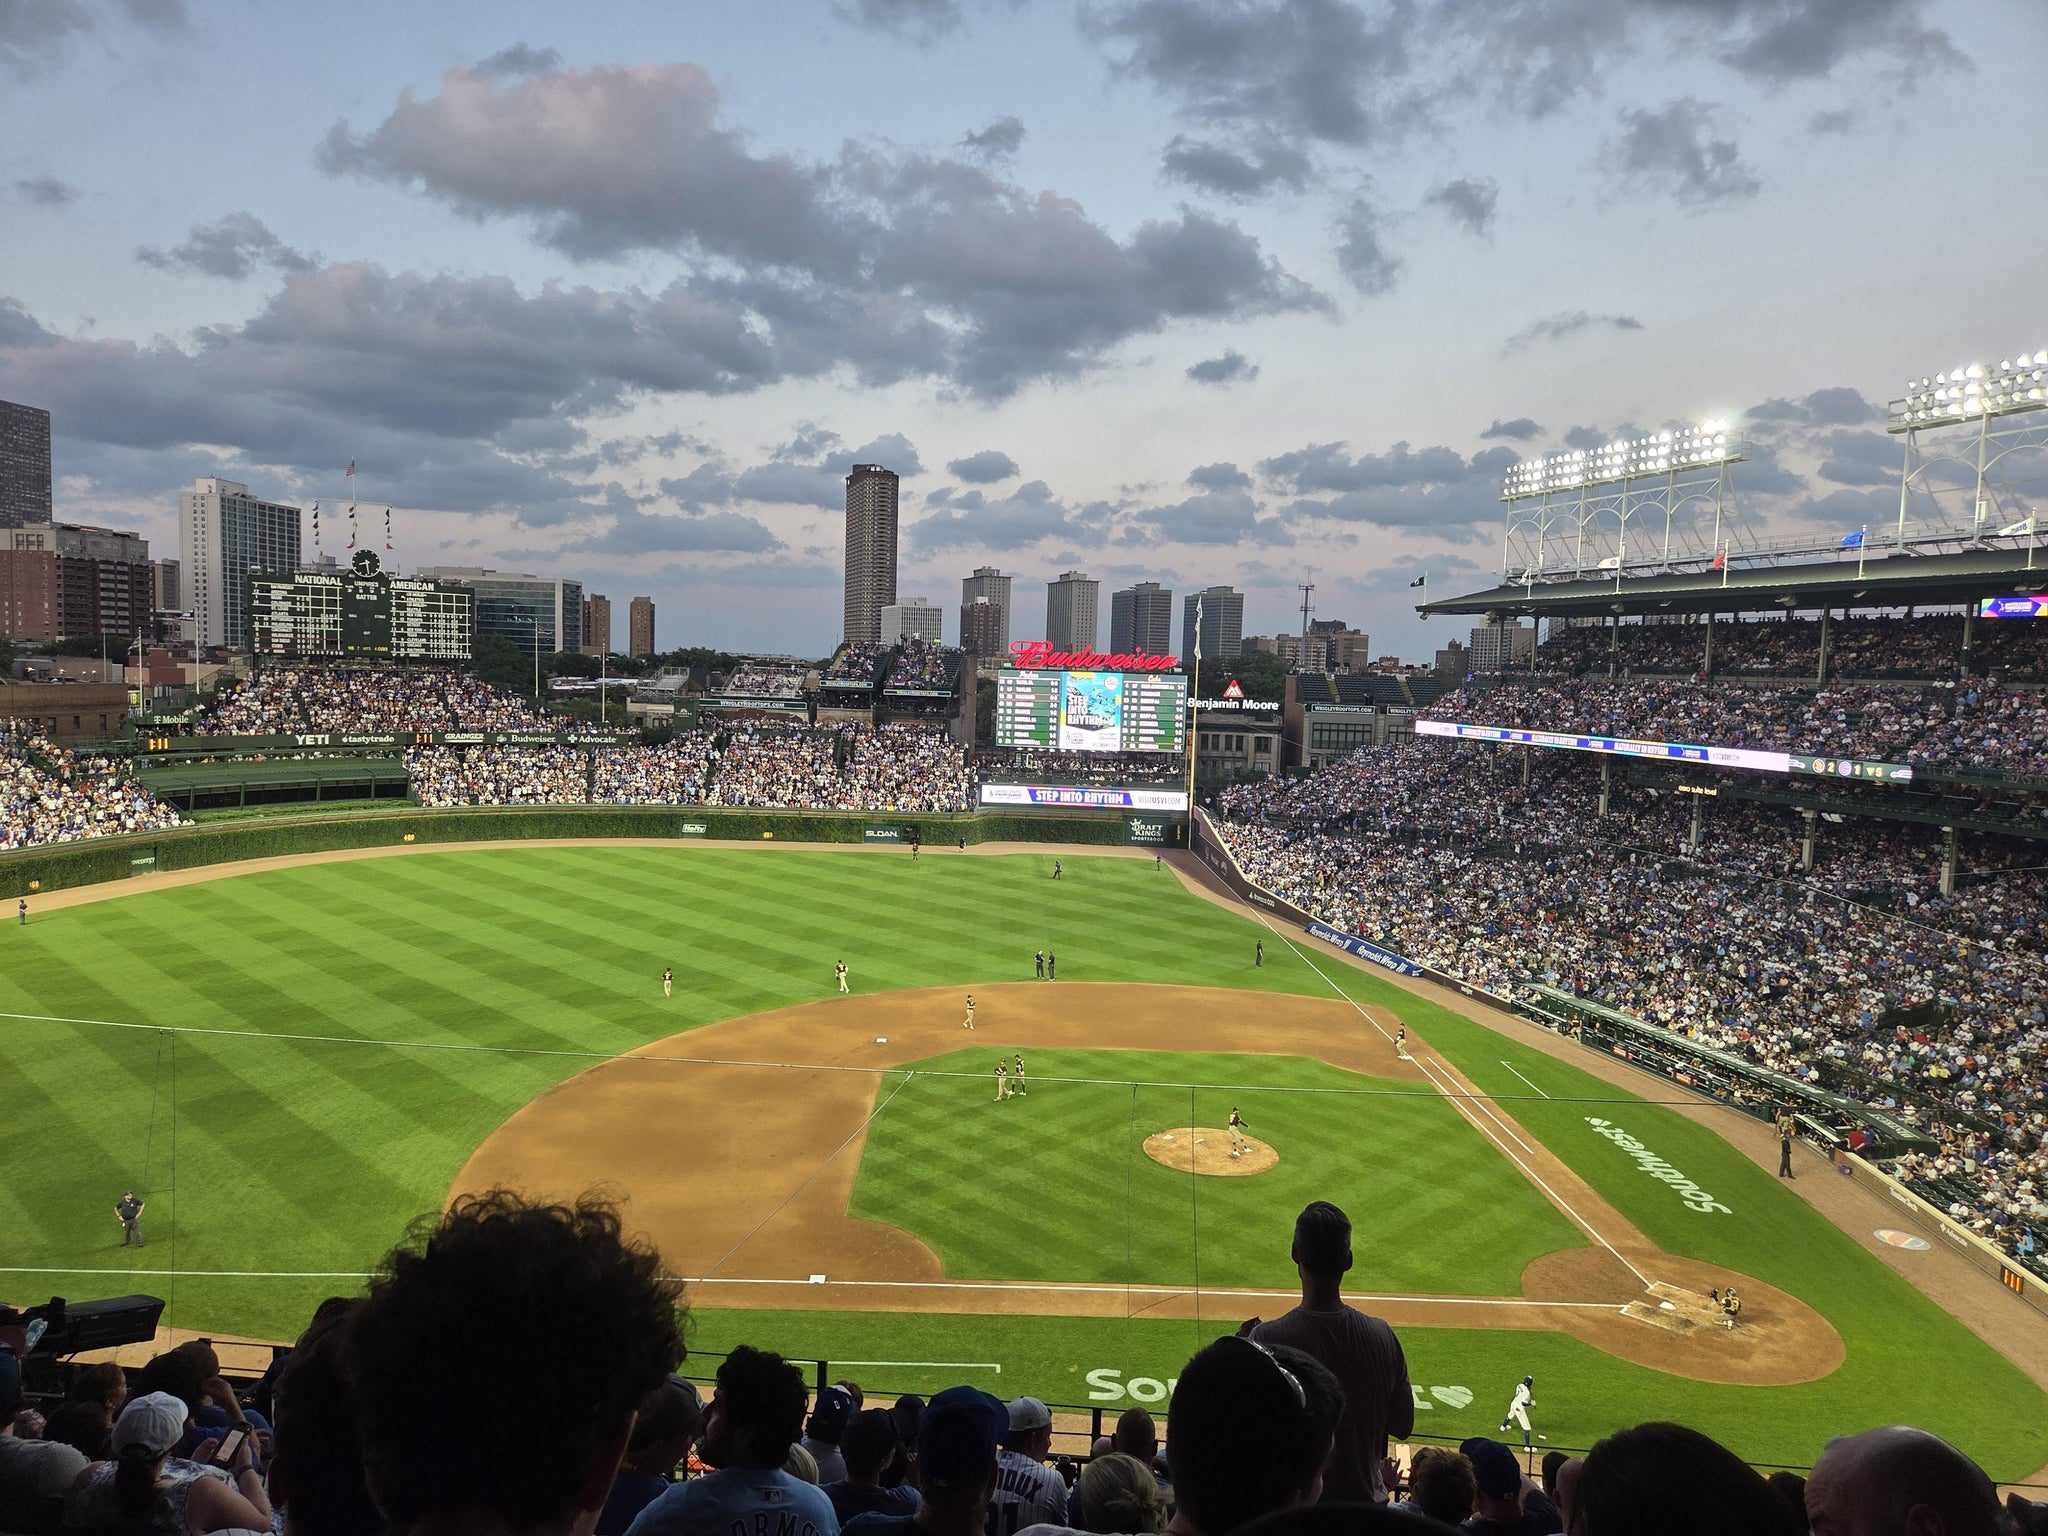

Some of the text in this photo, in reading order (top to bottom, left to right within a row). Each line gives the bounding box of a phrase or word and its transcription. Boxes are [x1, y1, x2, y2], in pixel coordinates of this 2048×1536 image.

[295, 575, 342, 585] NATIONAL
[390, 581, 434, 591] AMERICAN
[1009, 640, 1179, 670] Budweiser
[1068, 696, 1088, 704] STEP
[1188, 698, 1279, 710] Benjamin Moore
[1068, 705, 1088, 714] INTO
[162, 715, 189, 724] Mobile
[295, 735, 329, 745] YETI
[348, 736, 394, 744] tastytrade
[1827, 761, 1835, 773] 2
[1854, 764, 1861, 775] 1
[1036, 790, 1124, 804] STEP INTO RHYTHM
[684, 824, 704, 833] Hefty
[1310, 925, 1343, 947] Reynolds Wrap
[1356, 945, 1398, 970] Reynolds Wrap
[1592, 1126, 1732, 1214] Southwest
